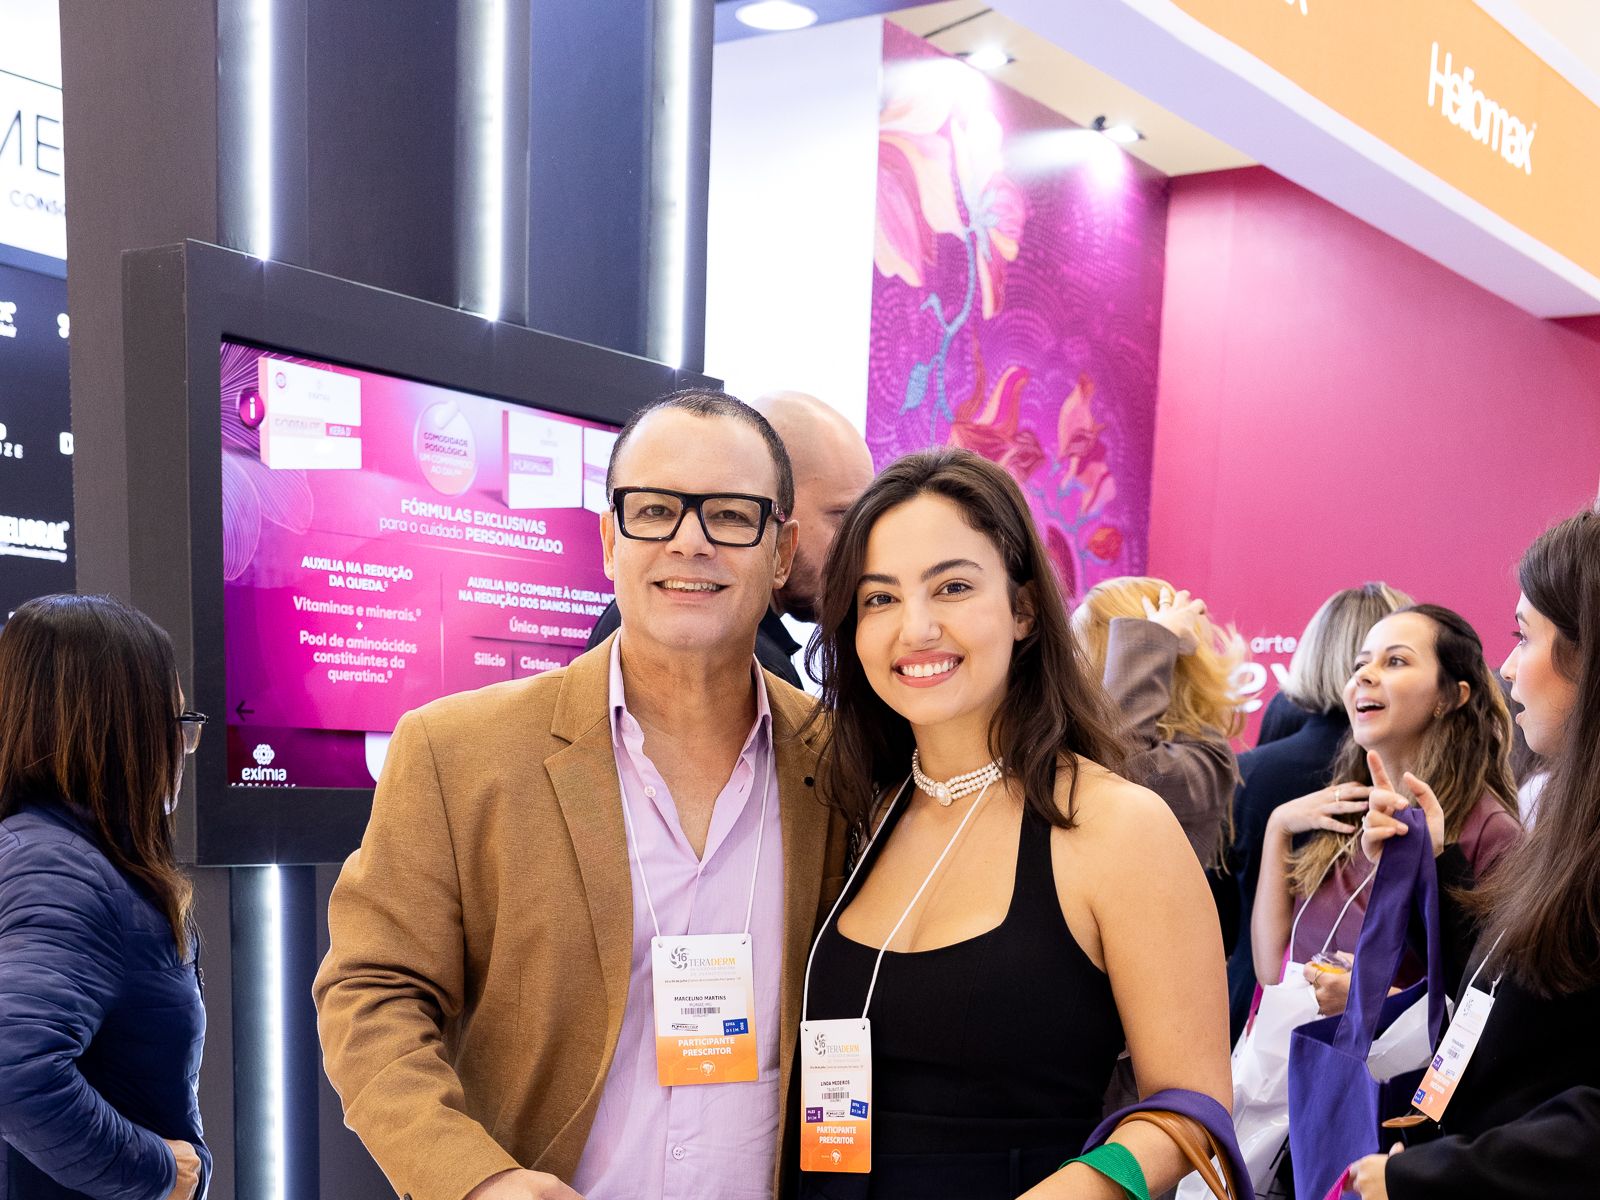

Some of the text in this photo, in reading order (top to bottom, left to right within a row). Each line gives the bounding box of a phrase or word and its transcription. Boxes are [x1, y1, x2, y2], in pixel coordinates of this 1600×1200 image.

[1427, 41, 1537, 175] Heliomax
[379, 517, 407, 532] para
[409, 522, 418, 533] o
[401, 497, 546, 535] FÓRMULAS EXCLUSIVAS
[301, 556, 413, 582] AUXILIA NA REDUÇÃO
[329, 575, 345, 588] DA
[467, 577, 505, 590] AUXILIA
[505, 581, 519, 594] NO
[520, 583, 562, 598] COMBATE
[571, 589, 600, 604] QUEDA
[293, 596, 354, 615] Vitaminas
[356, 606, 364, 616] e
[458, 590, 473, 603] NA
[474, 592, 520, 609] REDUÇÃO
[520, 597, 540, 610] DOS
[540, 600, 571, 614] DANOS
[571, 602, 585, 614] NA
[509, 616, 539, 634] Único
[540, 624, 560, 638] que
[299, 630, 417, 654] Pool de aminoácidos
[1250, 634, 1297, 654] arte
[313, 651, 405, 669] constituintes da
[678, 1038, 735, 1047] PARTICIPANTE
[682, 1046, 732, 1056] PRESCRITOR
[816, 1126, 857, 1134] PARTICIPANTE
[819, 1135, 854, 1145] PRESCRITOR
